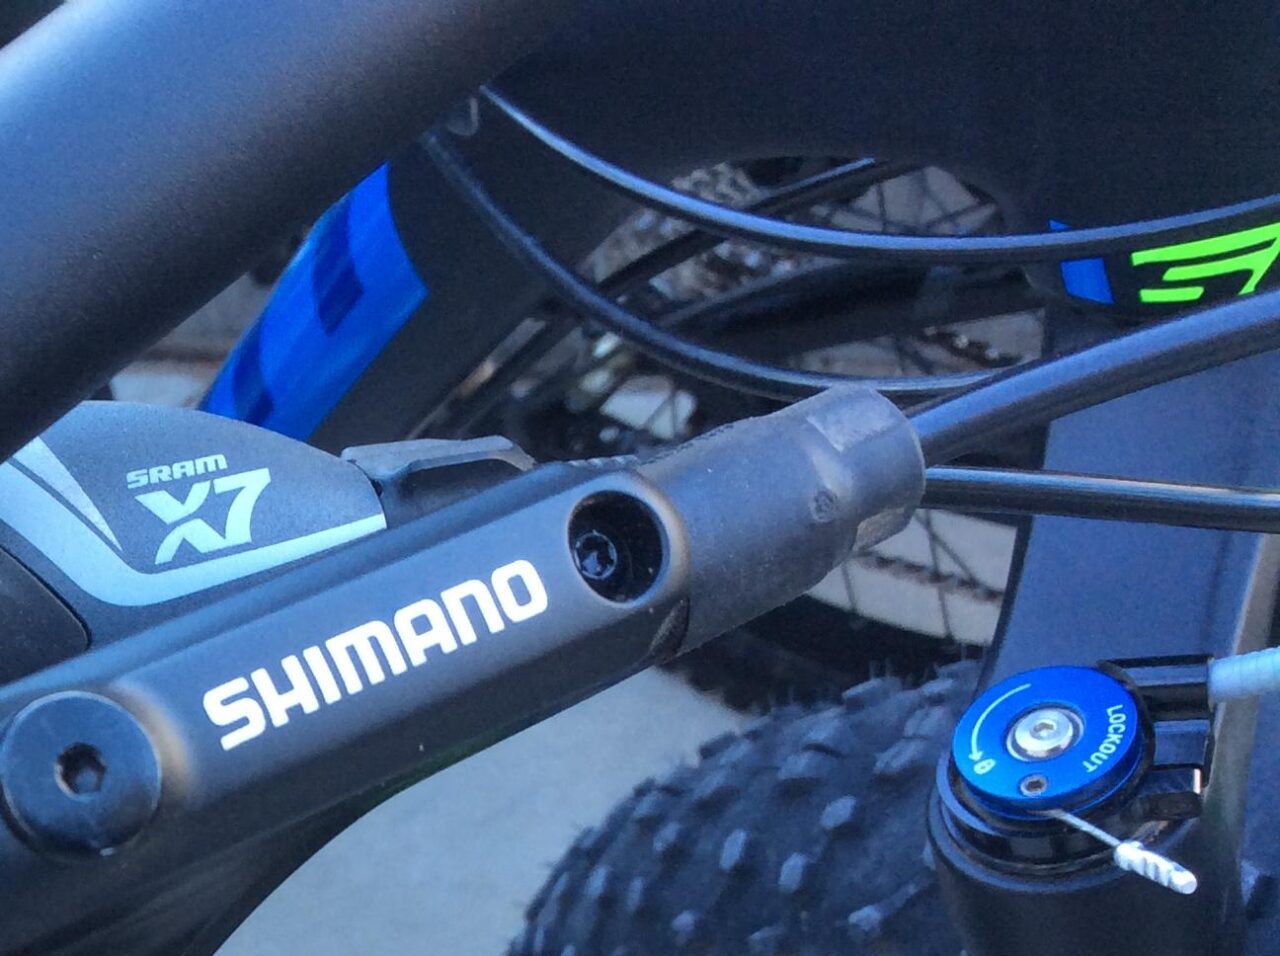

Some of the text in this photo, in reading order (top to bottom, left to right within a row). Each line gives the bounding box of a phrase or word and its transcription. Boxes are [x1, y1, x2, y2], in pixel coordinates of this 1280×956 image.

[126, 453, 229, 489] SRAM
[133, 467, 272, 565] X7
[202, 558, 549, 752] SHIMANO
[1081, 704, 1127, 773] LOCKOUT
